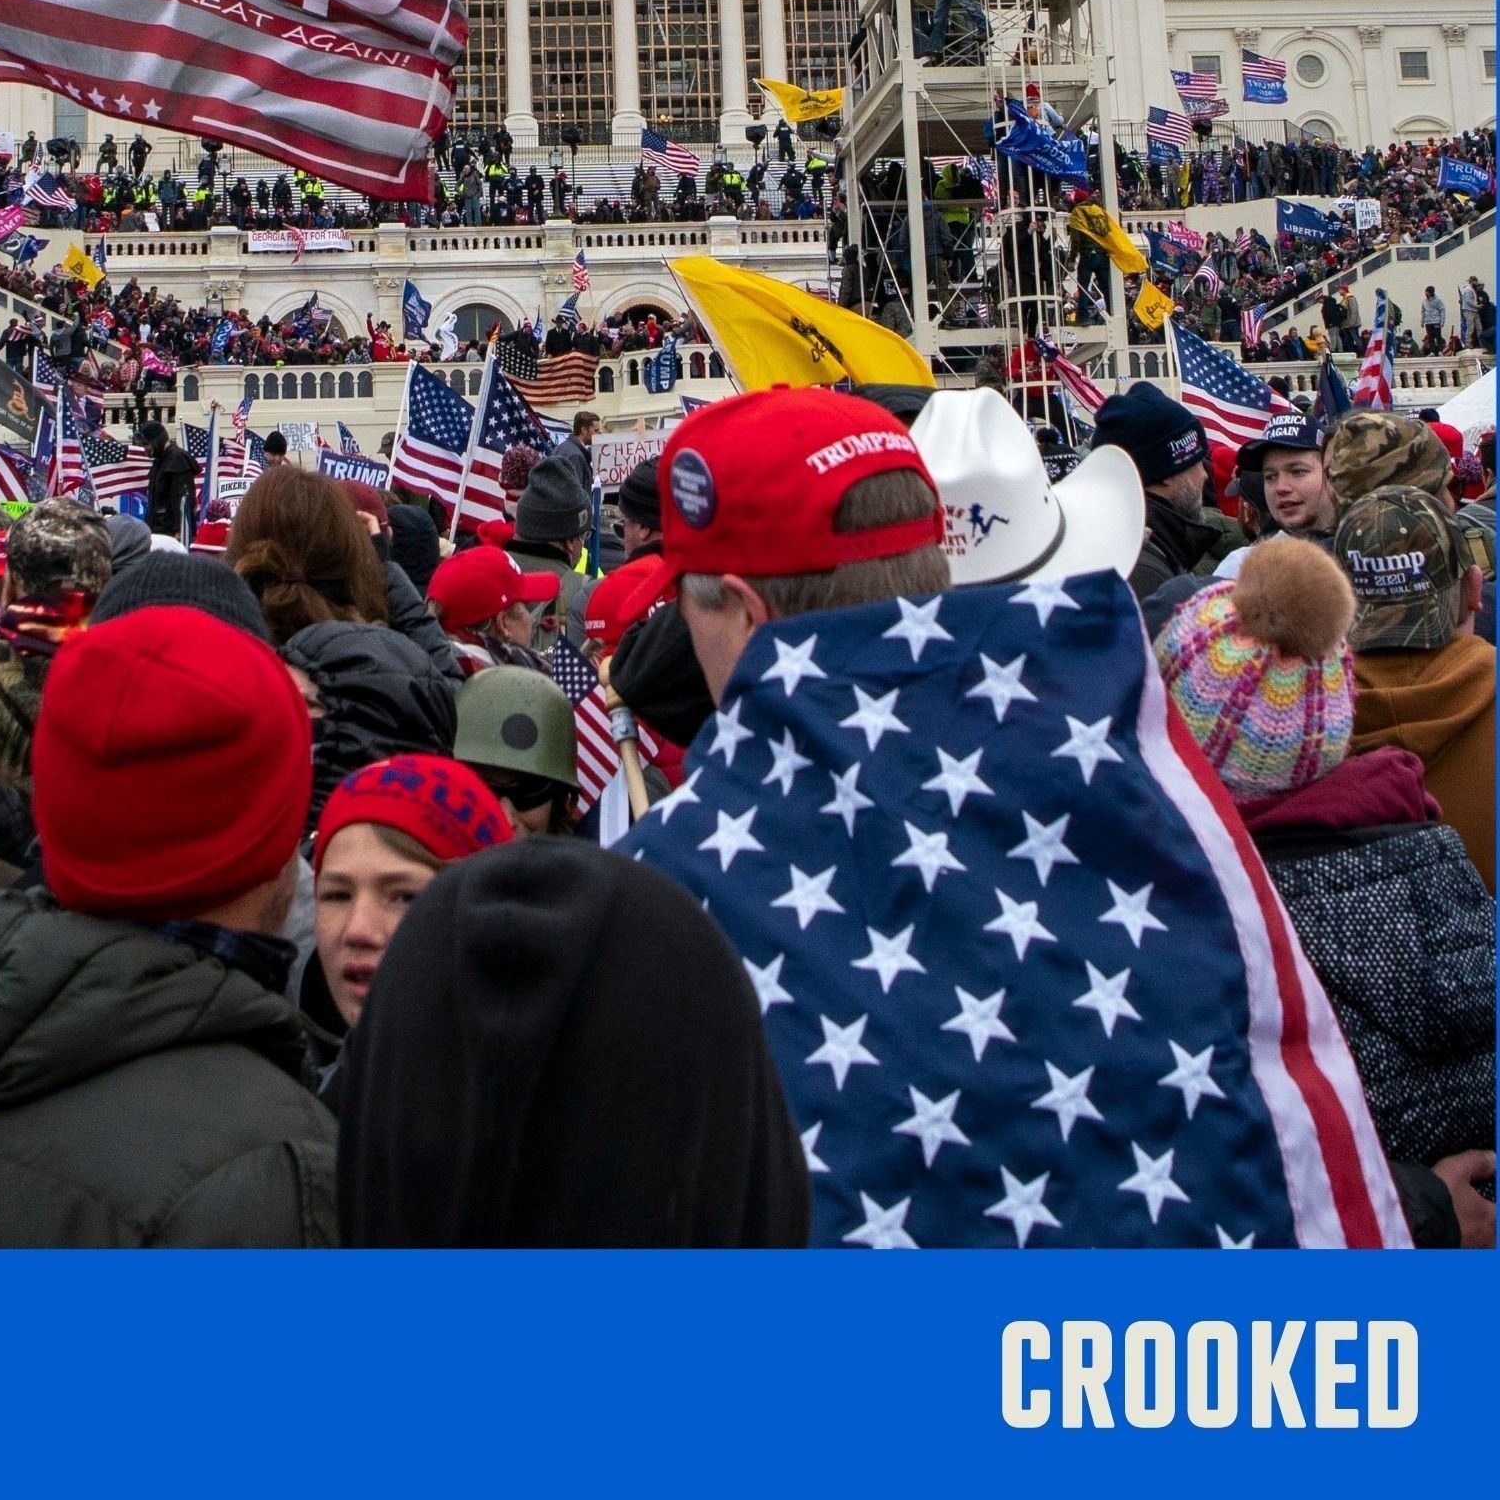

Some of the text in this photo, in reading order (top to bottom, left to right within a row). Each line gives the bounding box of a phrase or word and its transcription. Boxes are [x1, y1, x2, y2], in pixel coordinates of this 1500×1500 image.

[281, 25, 411, 68] AGAIN!
[1247, 79, 1282, 90] TRUMP
[1447, 162, 1489, 181] TRUMP
[252, 231, 286, 242] GEORGIA
[287, 231, 307, 241] FIGT
[310, 231, 326, 241] FOR
[1284, 223, 1326, 240] LIBERTY
[280, 423, 312, 435] SEND
[1269, 426, 1299, 438] AGAIN
[1168, 429, 1198, 452] Trump
[323, 457, 387, 488] TRUMP
[220, 481, 247, 493] BIKERS
[1347, 549, 1426, 575] Trump
[1374, 572, 1406, 587] 2020
[1365, 587, 1388, 596] MORE
[1389, 585, 1411, 595] BULL
[1413, 581, 1430, 591] SHIT
